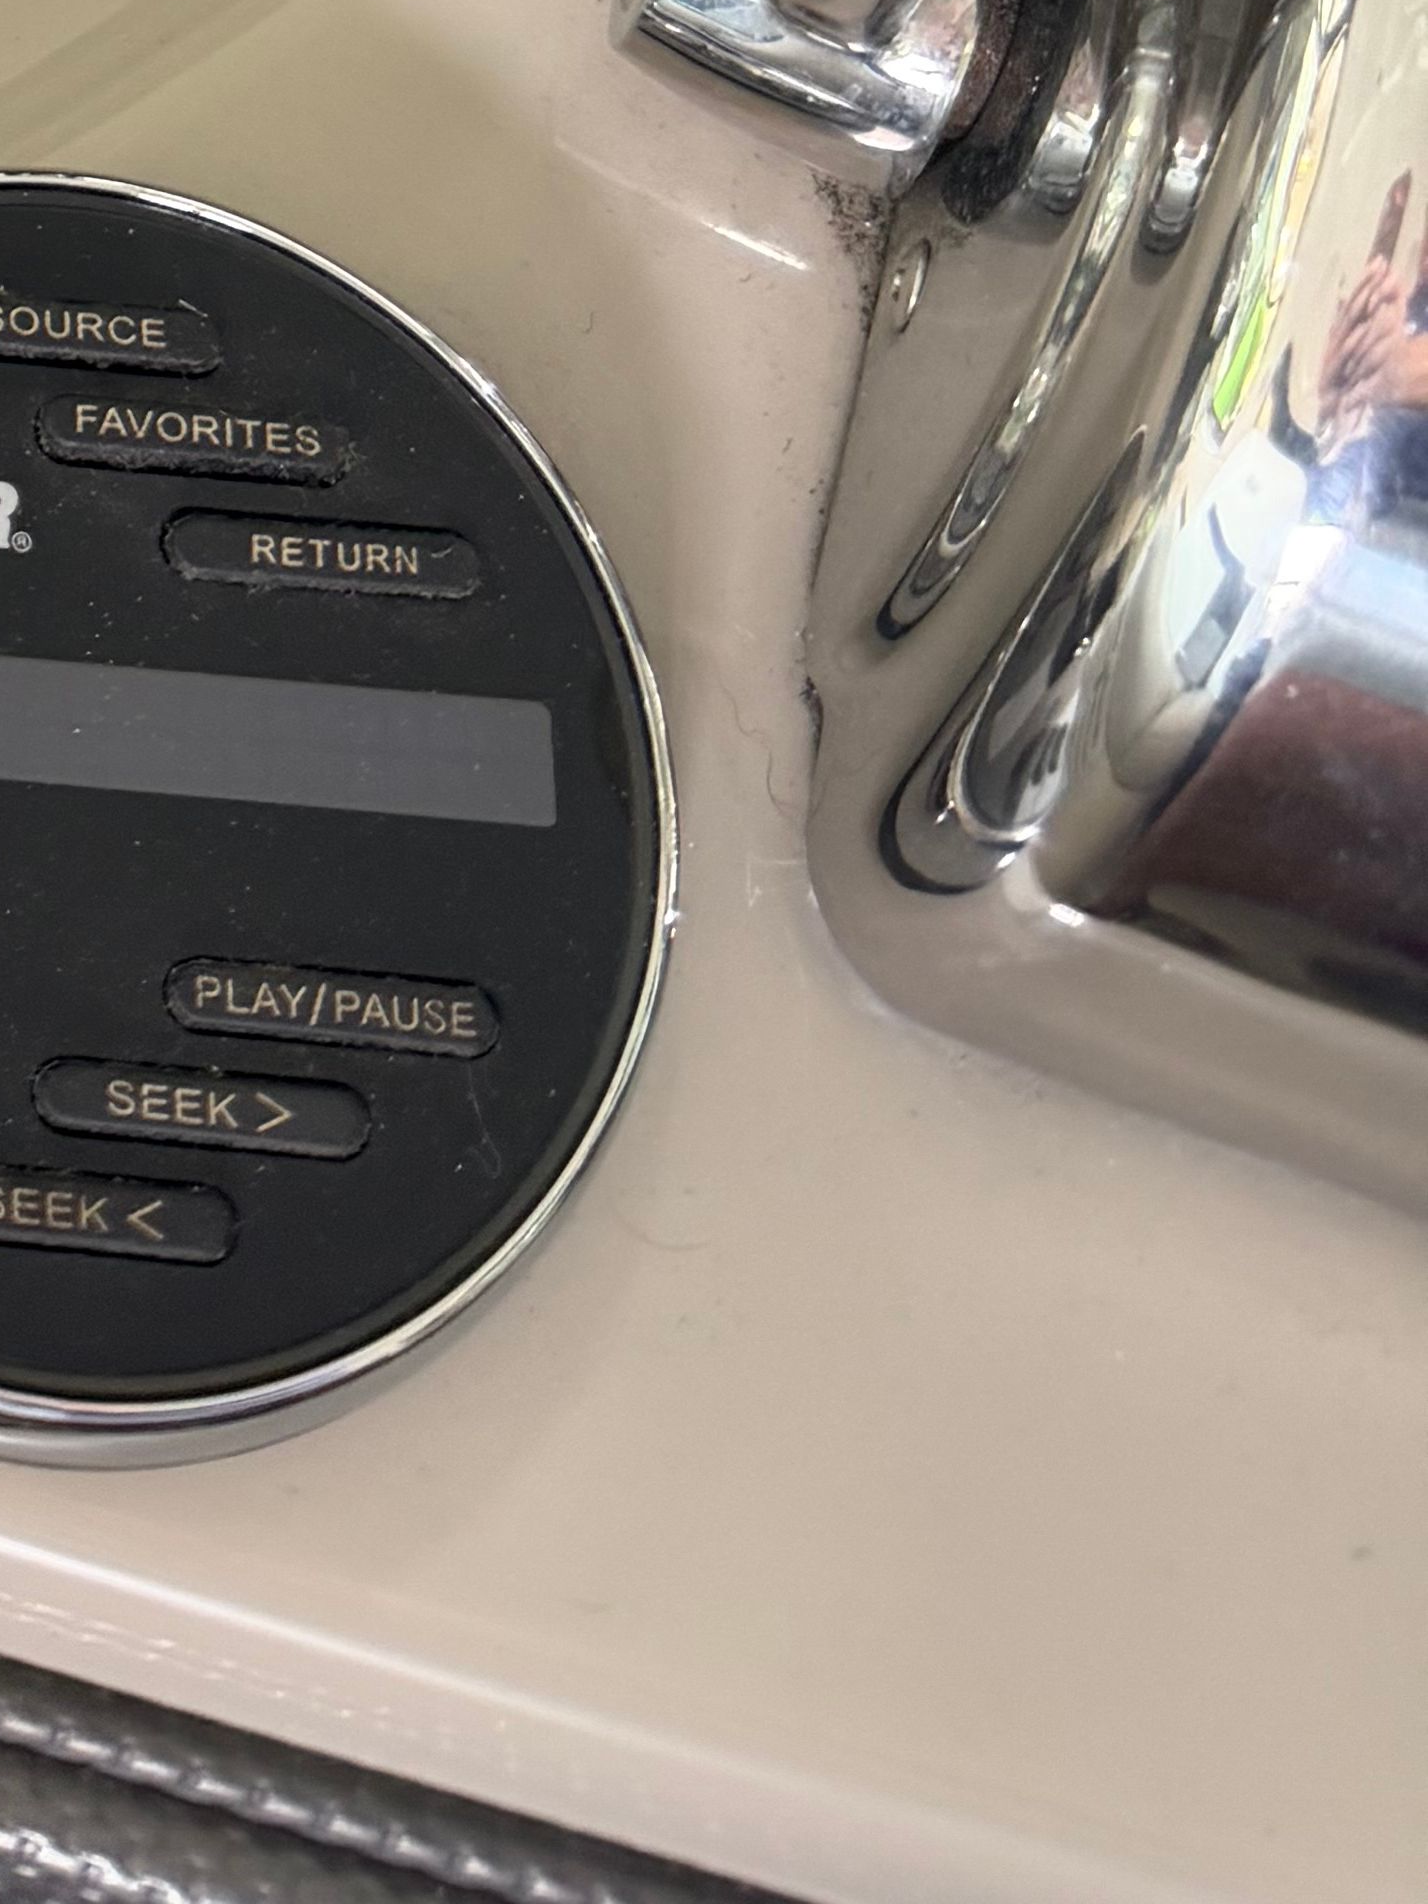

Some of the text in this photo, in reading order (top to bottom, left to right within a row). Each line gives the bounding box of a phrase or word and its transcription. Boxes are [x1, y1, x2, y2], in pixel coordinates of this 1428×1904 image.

[75, 405, 322, 458] FAVORITES
[250, 534, 420, 575] RETURN
[194, 980, 477, 1039] PLAY/PAUSE
[106, 1080, 236, 1126] SEEK
